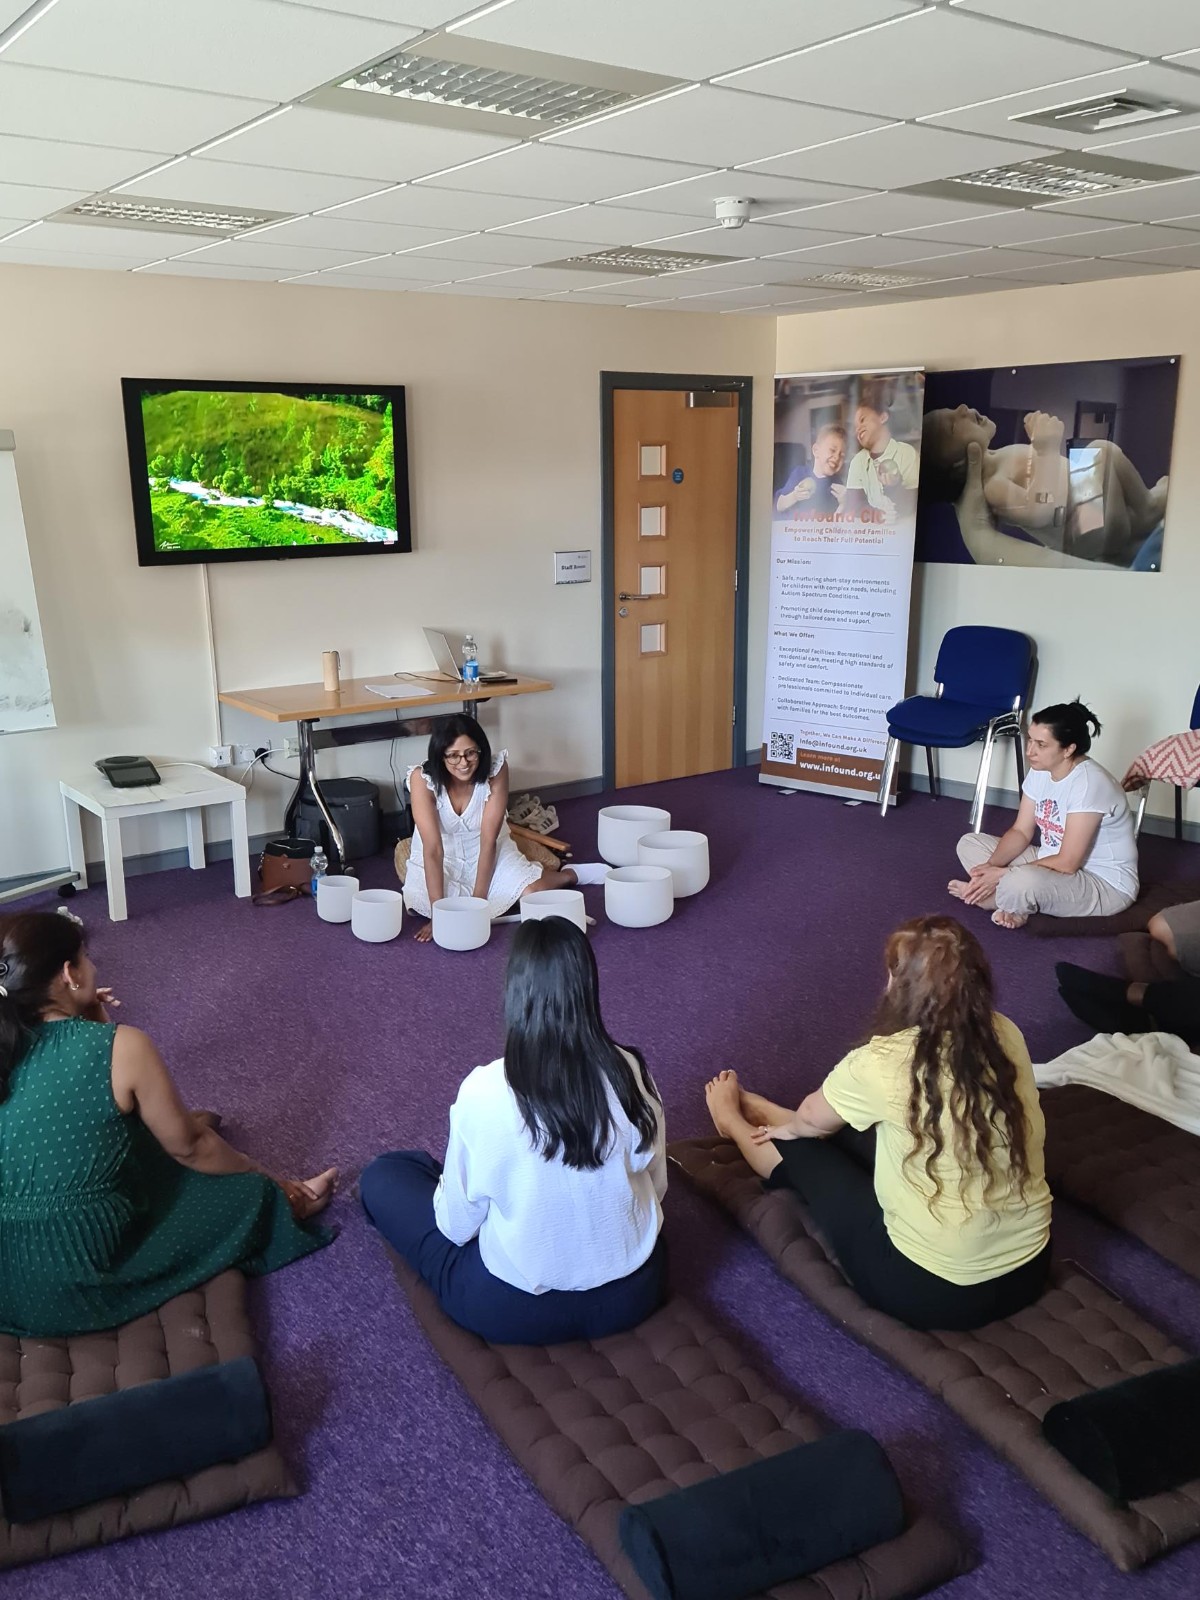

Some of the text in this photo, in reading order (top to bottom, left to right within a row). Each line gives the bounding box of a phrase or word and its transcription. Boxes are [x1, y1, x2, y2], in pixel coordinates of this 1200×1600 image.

[861, 509, 886, 524] CIC
[784, 527, 823, 535] Empowering
[837, 651, 872, 659] Recreational
[822, 657, 844, 665] meeting
[778, 684, 812, 692] professionals
[821, 680, 863, 689] Compassionate
[777, 697, 811, 706] Collaborative
[812, 701, 838, 709] Approach:
[840, 704, 858, 713] Strong
[800, 762, 881, 781] www.infound.org.u
